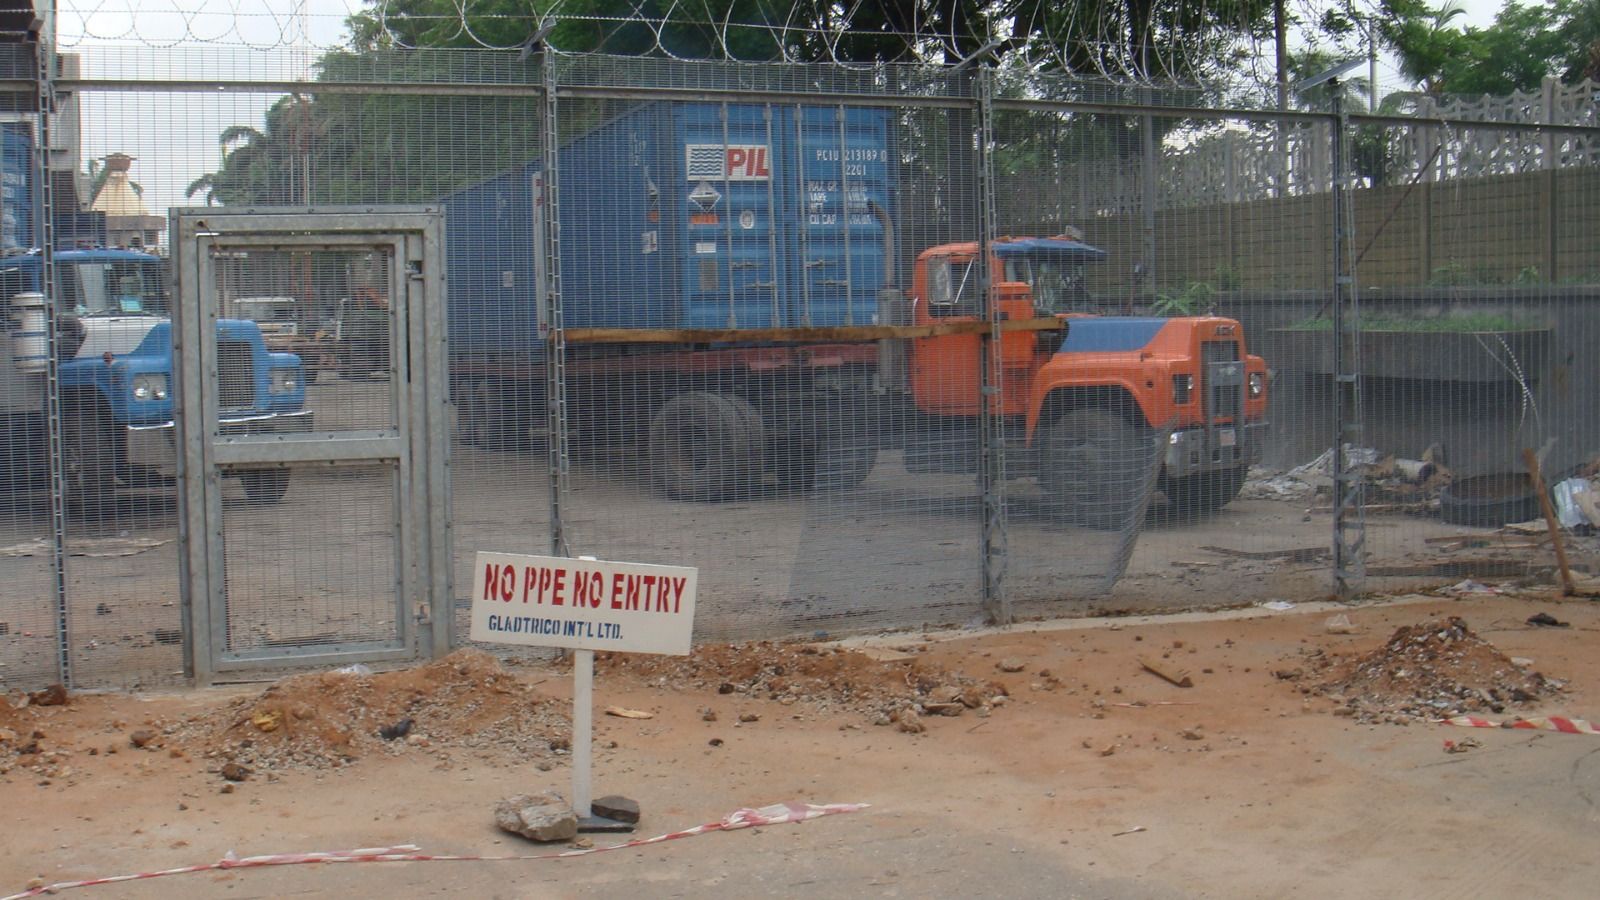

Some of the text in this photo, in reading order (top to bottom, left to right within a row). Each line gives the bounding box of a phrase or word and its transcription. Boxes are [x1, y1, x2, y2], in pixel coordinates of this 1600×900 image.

[727, 148, 769, 177] PIL
[816, 149, 839, 161] PCIU
[845, 149, 878, 161] 213189
[483, 563, 687, 614] NO PPE NO ENTRY
[488, 614, 560, 635] GLADTRICO
[597, 622, 623, 639] LTD.
